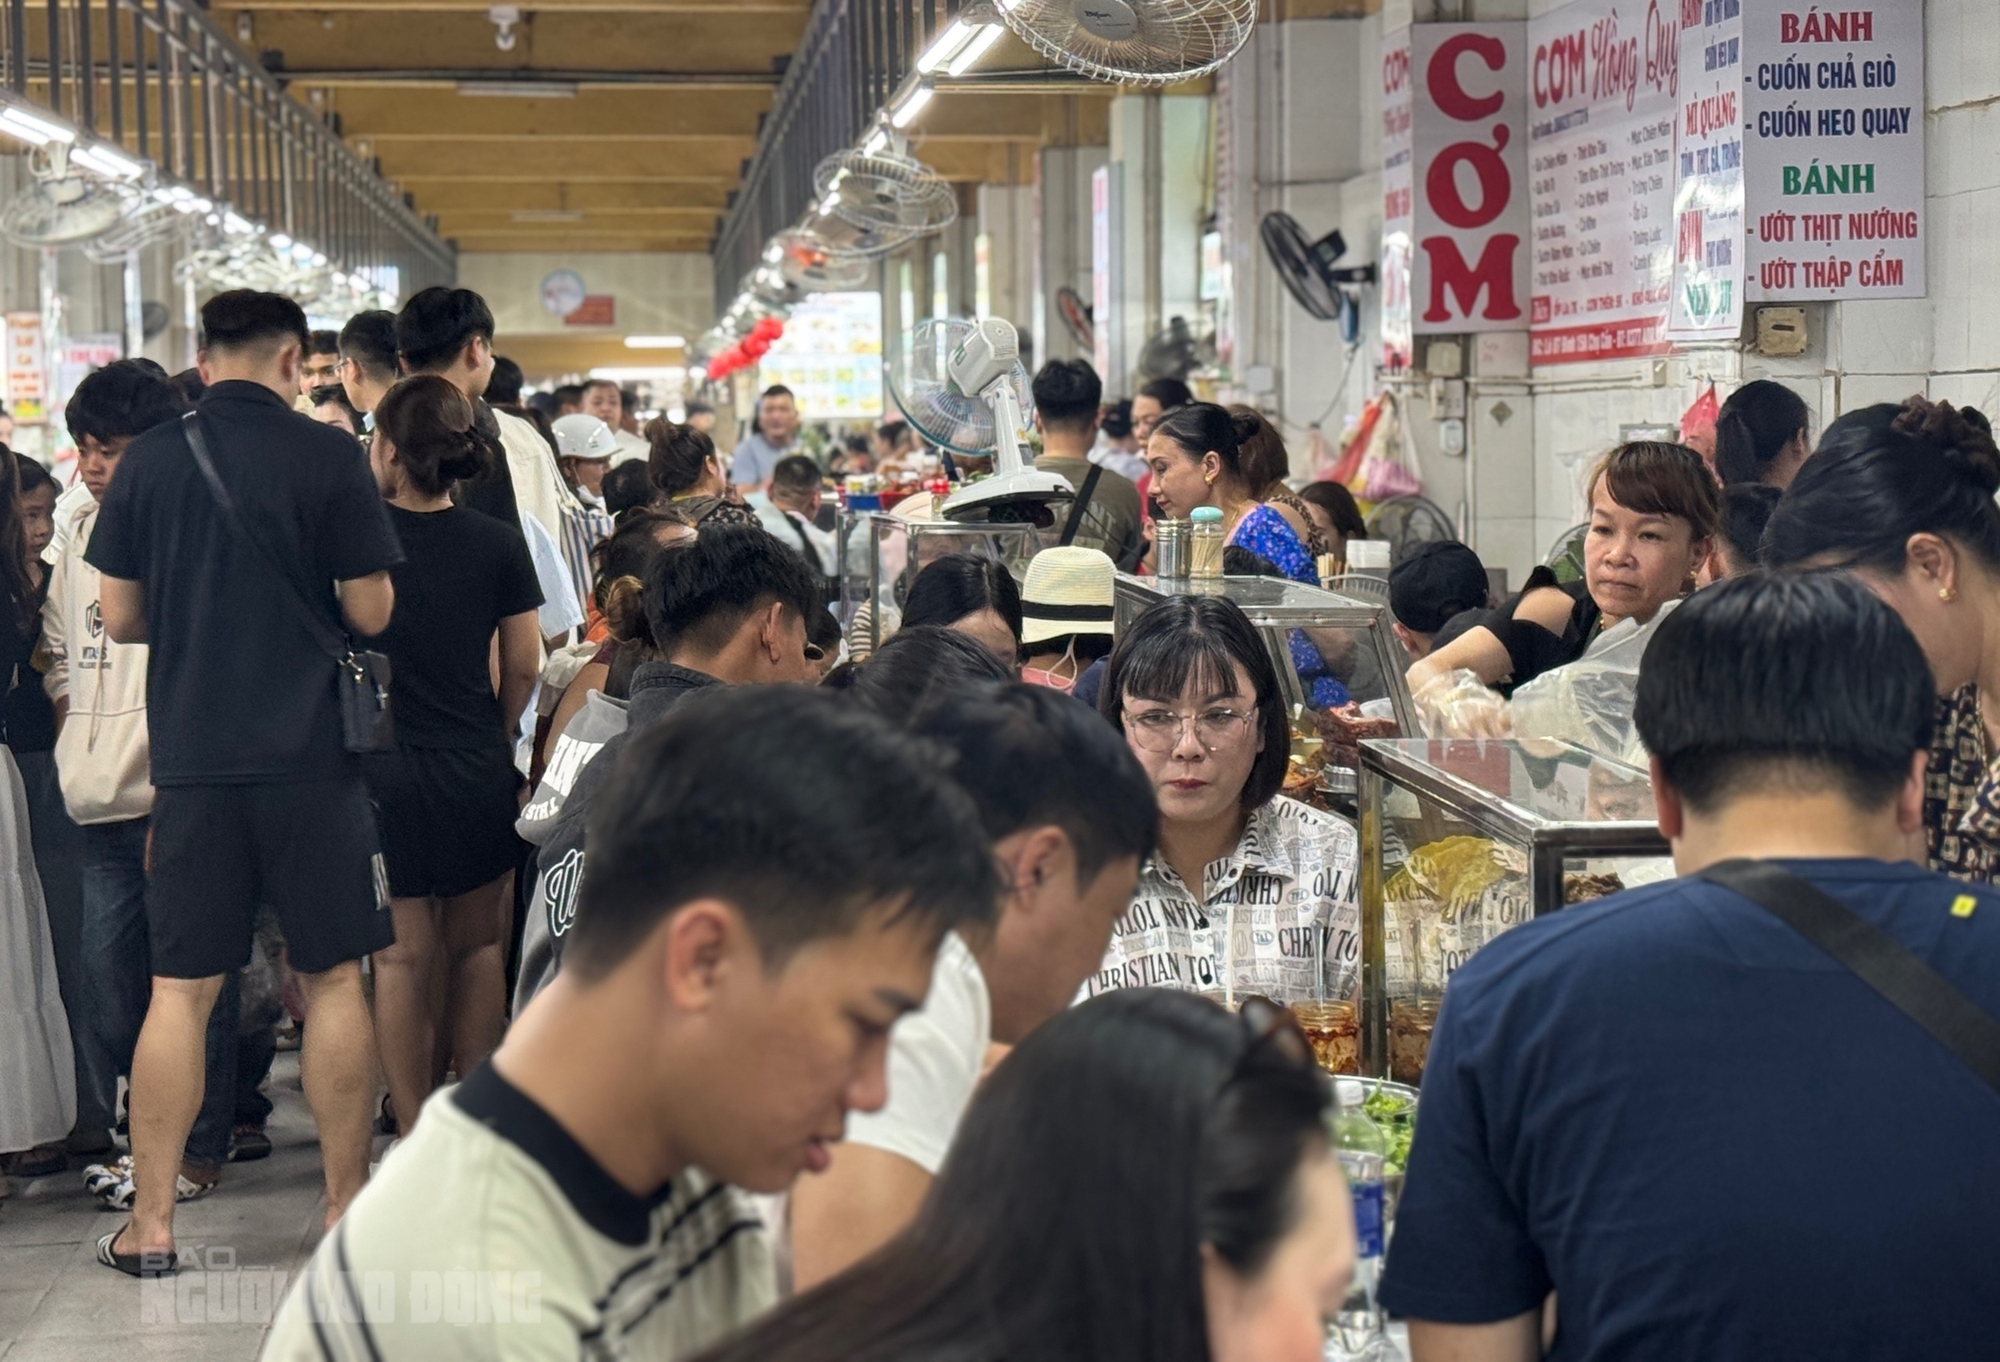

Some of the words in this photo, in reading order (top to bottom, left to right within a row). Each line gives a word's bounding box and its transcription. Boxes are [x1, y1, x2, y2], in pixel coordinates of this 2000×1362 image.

[1781, 6, 1873, 43] BÁNH
[1534, 29, 1585, 108] CƠM
[1758, 53, 1811, 90] CUỐN
[1817, 52, 1857, 89] CHẢ
[1863, 54, 1896, 88] GIÒ
[1686, 91, 1698, 137] MÌ
[1701, 80, 1736, 140] QUẢNG
[1758, 100, 1811, 138] CUỐN
[1818, 108, 1855, 136] HEO
[1862, 107, 1911, 138] QUAY
[1421, 33, 1521, 322] CƠM
[1783, 158, 1875, 195] BÁNH
[1760, 210, 1796, 242] ƯỚT
[1802, 214, 1842, 247] THỊT
[1849, 207, 1918, 240] NƯỚNG
[1761, 257, 1797, 290] ƯỚT
[1803, 255, 1852, 293] THẬP
[1858, 249, 1903, 287] CẨM
